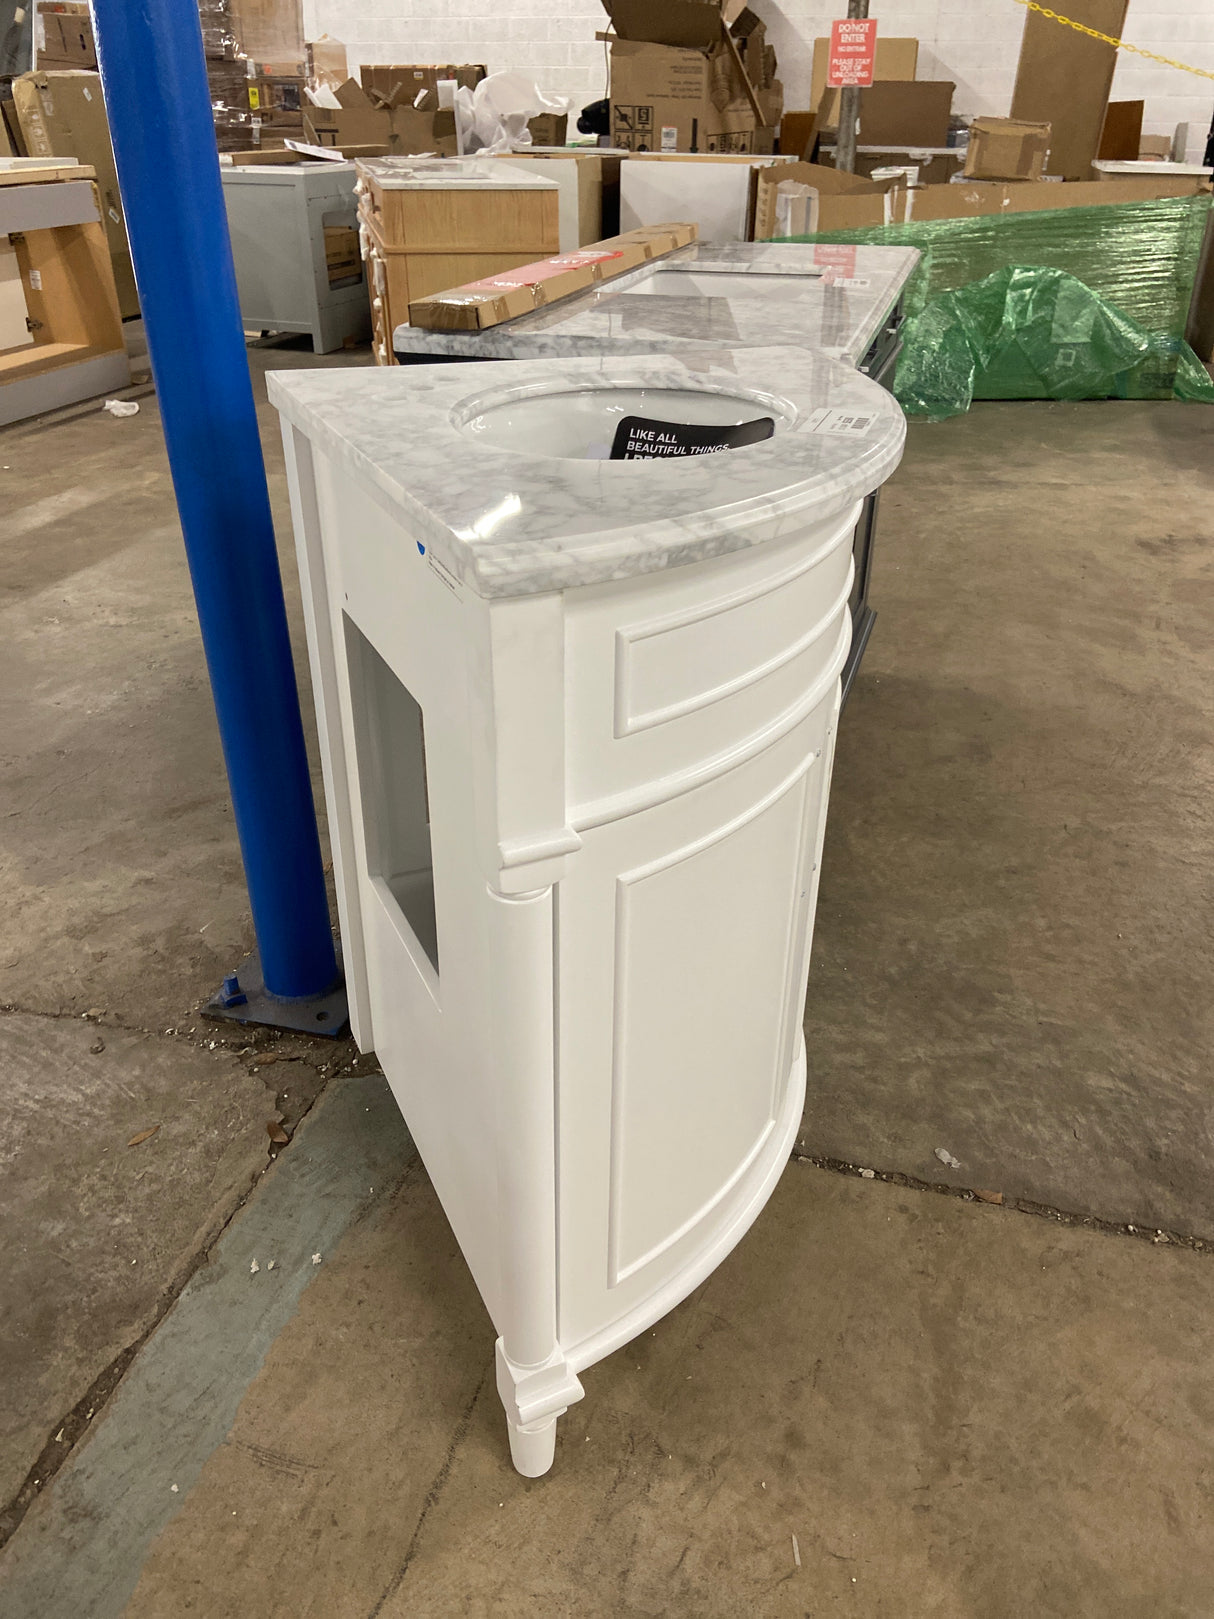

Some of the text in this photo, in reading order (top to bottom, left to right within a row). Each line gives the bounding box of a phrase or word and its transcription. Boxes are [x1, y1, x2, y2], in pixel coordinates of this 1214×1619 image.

[838, 24, 870, 32] DO NOT
[841, 34, 865, 43] ENTER
[630, 428, 678, 444] LIKE ALL
[626, 441, 729, 455] BEAUTIFUL THINGS
